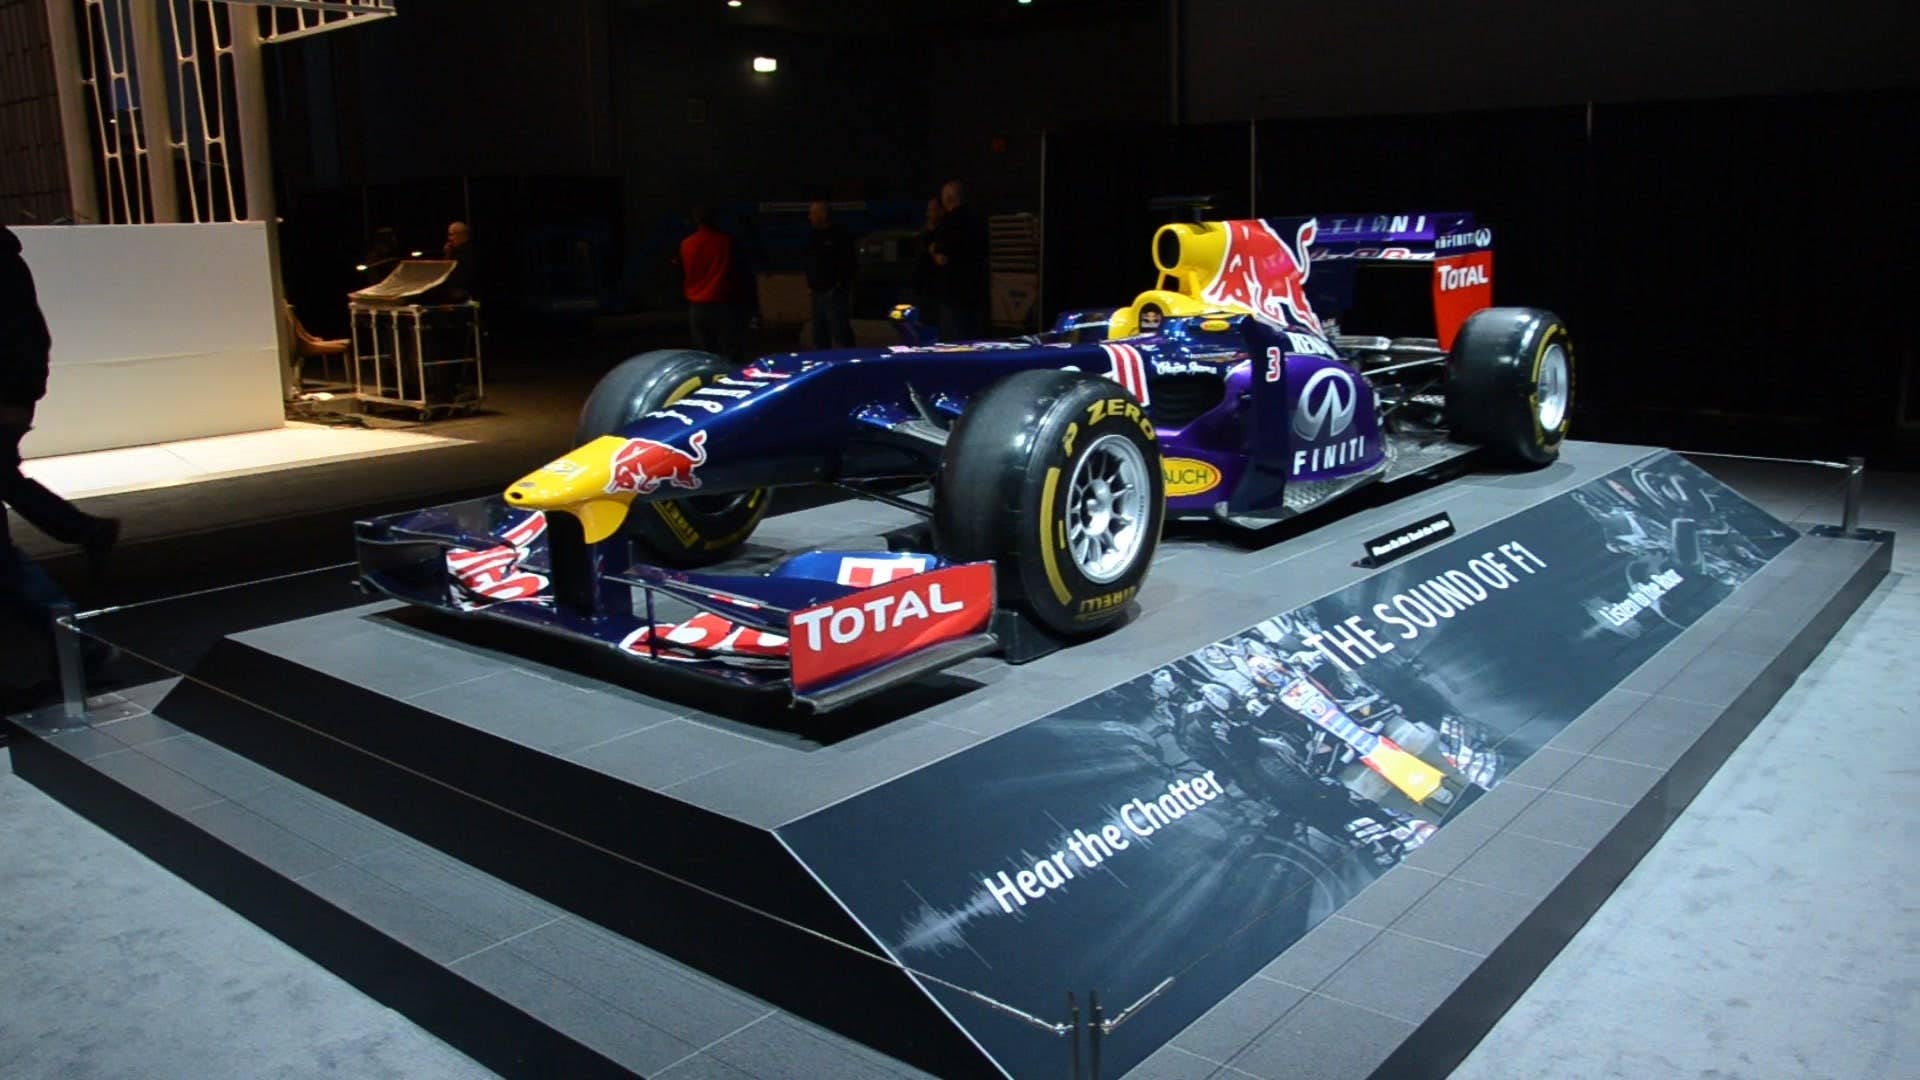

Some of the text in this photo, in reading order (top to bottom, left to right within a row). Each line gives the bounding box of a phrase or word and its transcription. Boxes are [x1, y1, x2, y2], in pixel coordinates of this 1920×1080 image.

[1438, 264, 1489, 291] TOTAL
[1265, 346, 1281, 382] 3
[1086, 399, 1157, 440] ZERO
[793, 583, 964, 652] TOTAL
[1302, 541, 1548, 672] THE SOUND OF F1
[983, 769, 1224, 914] Hear the Chatter
